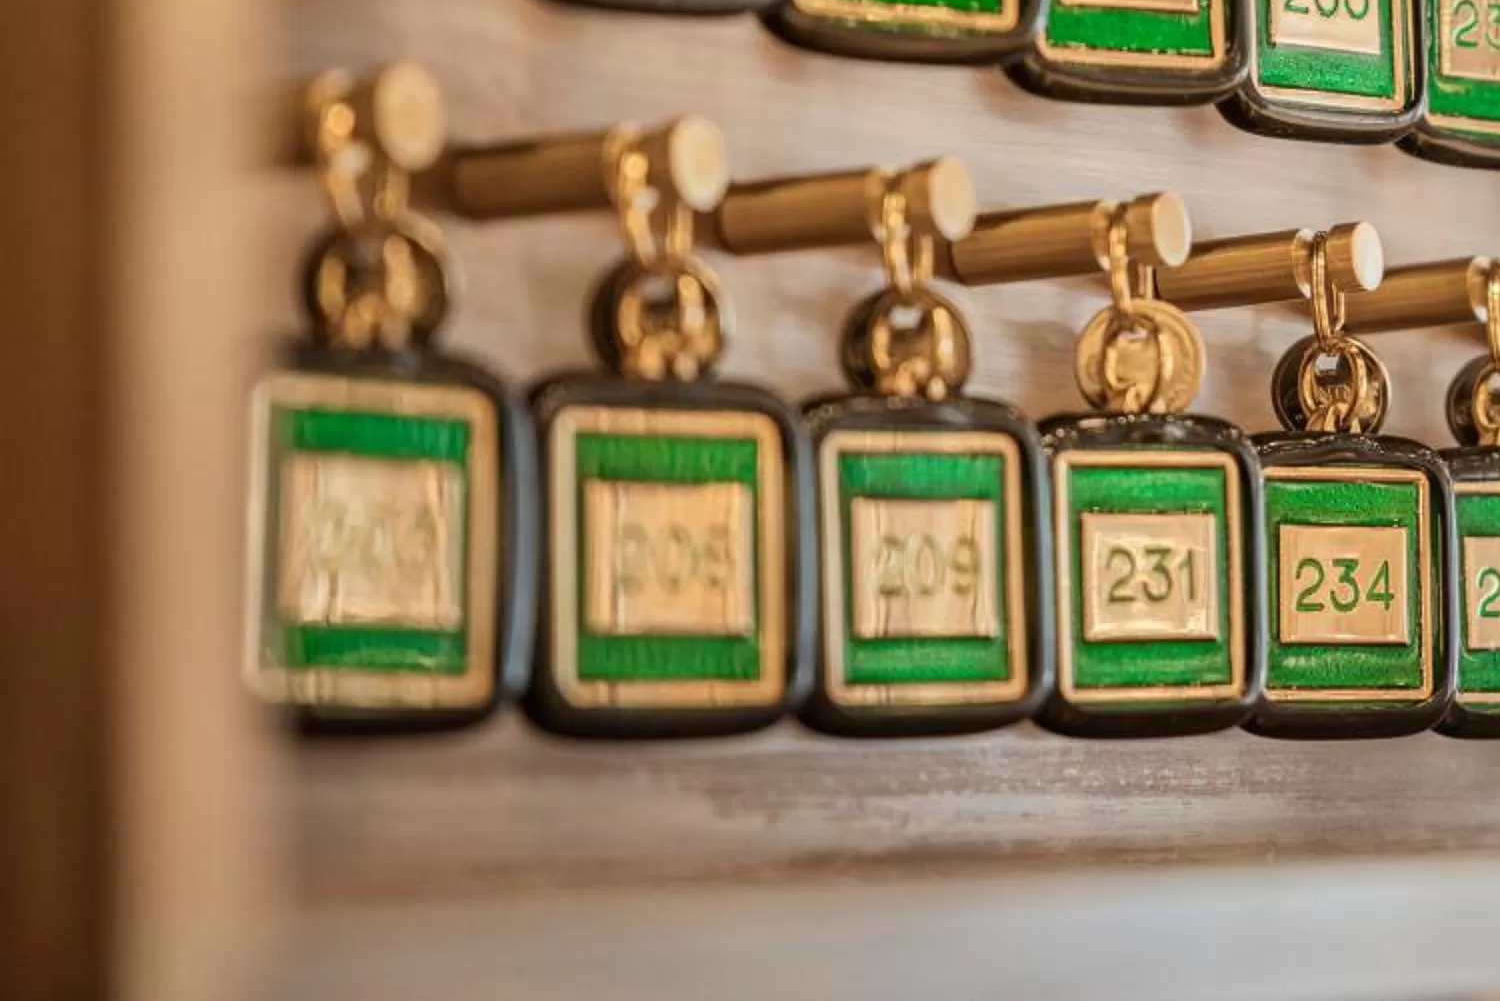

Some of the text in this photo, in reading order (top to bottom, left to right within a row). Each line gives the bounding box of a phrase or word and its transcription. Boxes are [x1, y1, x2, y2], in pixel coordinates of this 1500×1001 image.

[876, 535, 981, 597] 209
[1105, 547, 1199, 603] 231
[1294, 558, 1396, 612] 234
